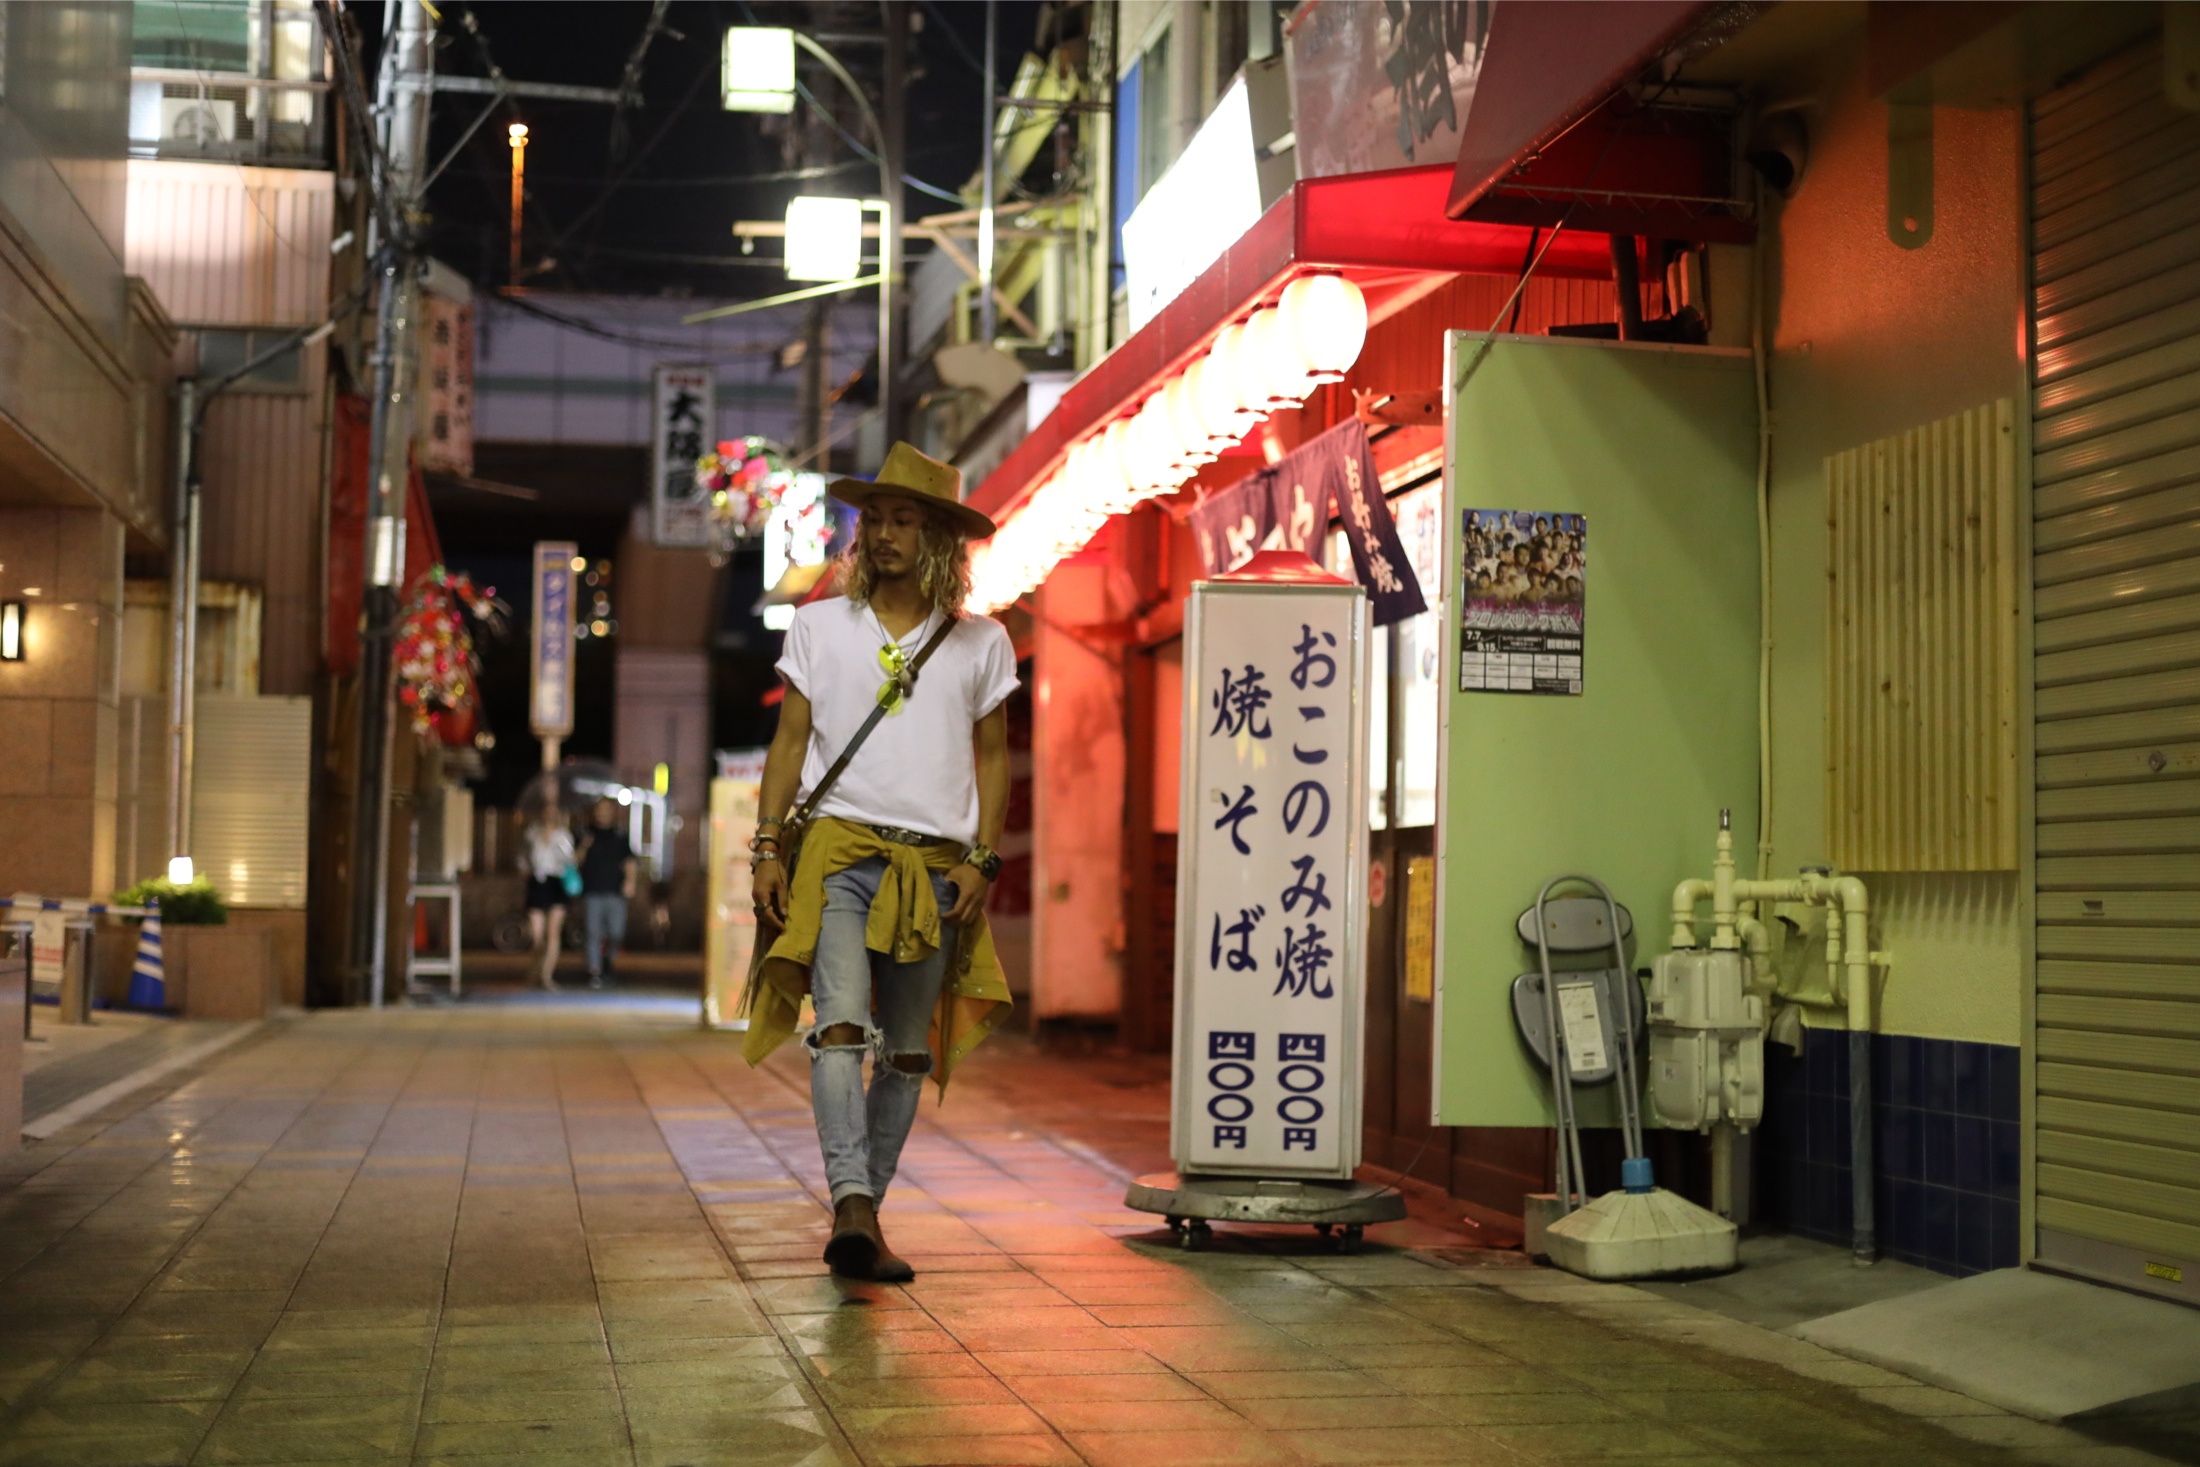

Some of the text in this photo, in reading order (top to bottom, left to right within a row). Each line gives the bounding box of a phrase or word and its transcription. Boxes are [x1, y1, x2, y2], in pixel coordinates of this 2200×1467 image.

[1210, 664, 1273, 972] 焼そば
[1273, 623, 1337, 1000] おこのみ焼
